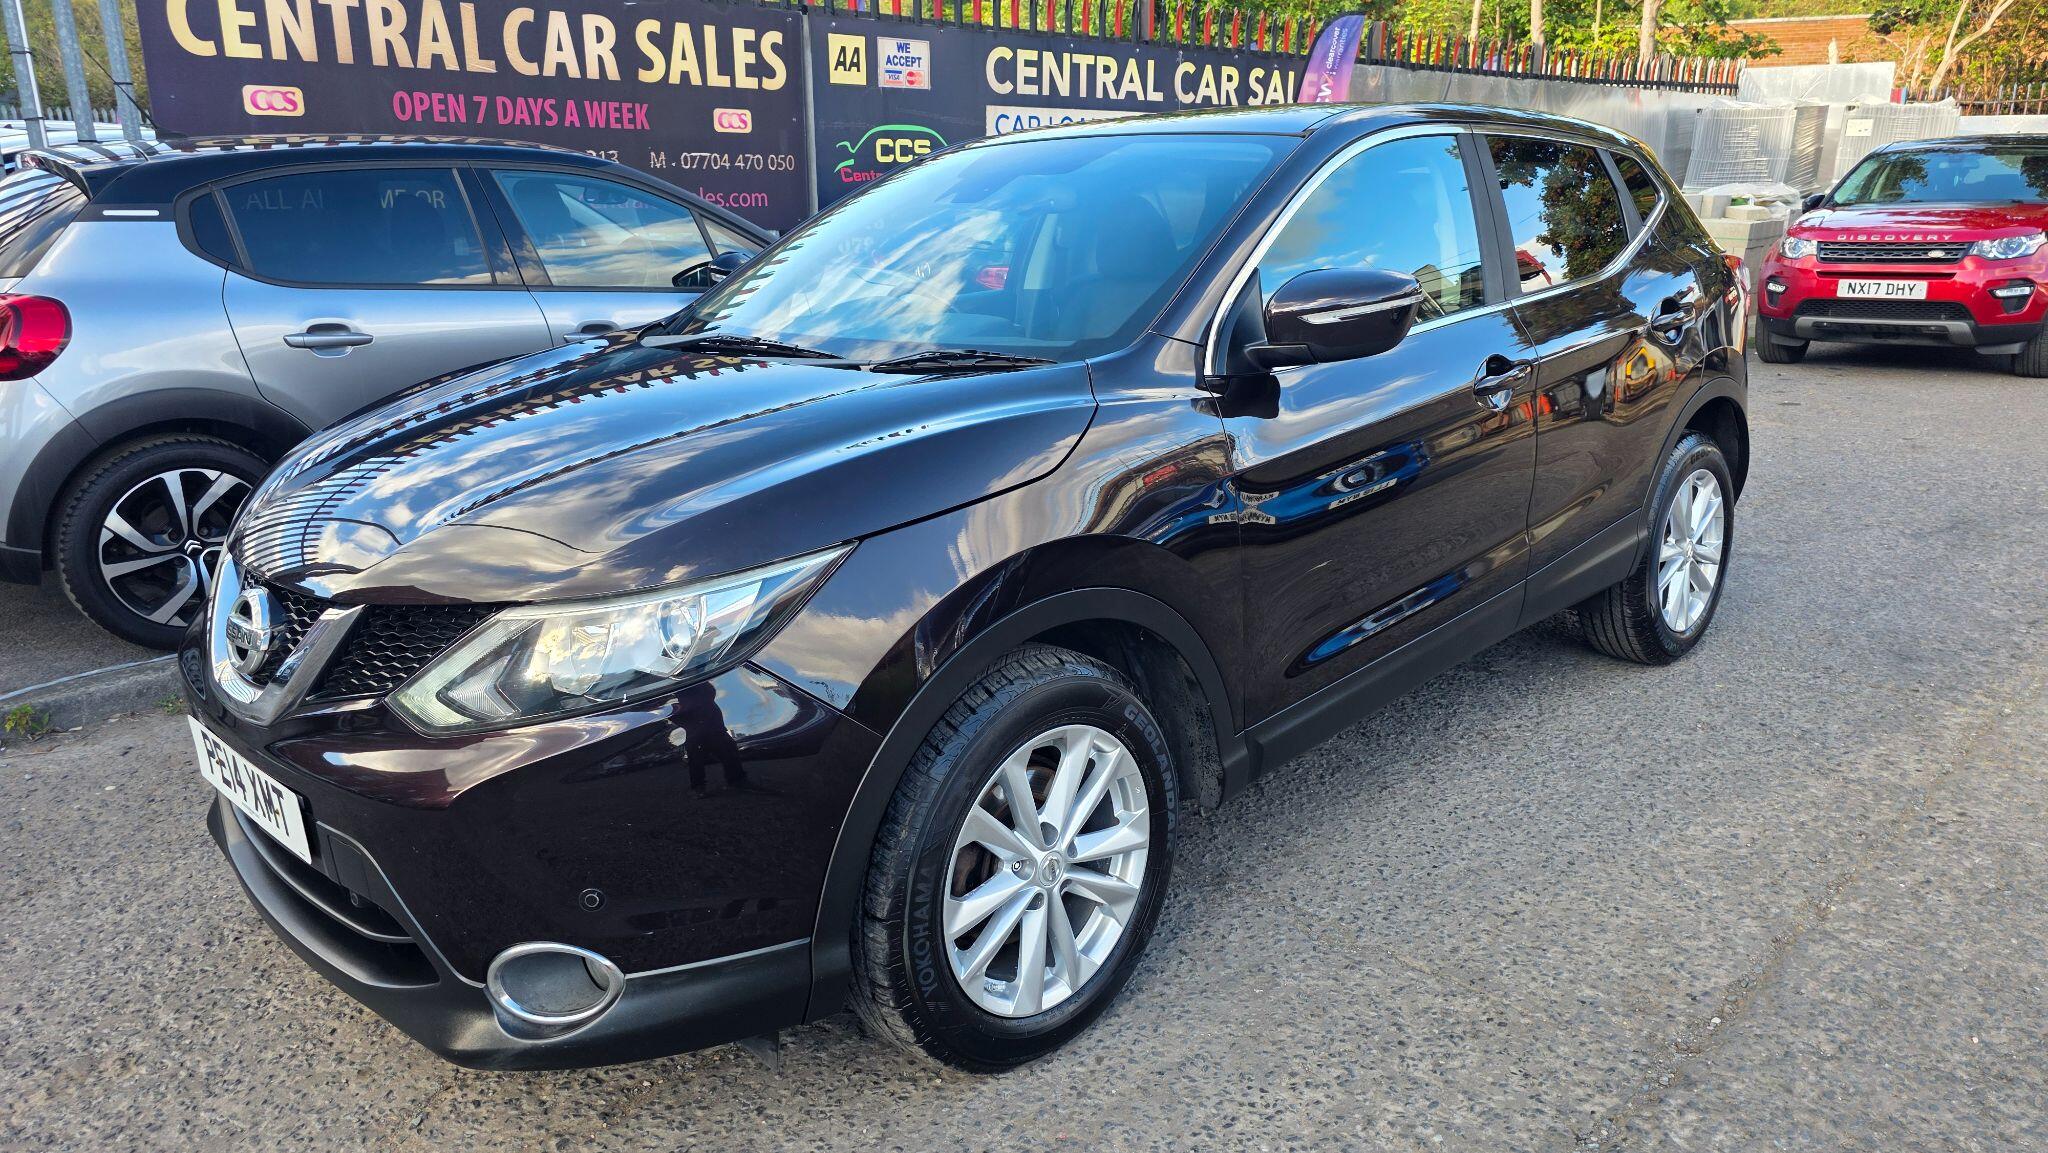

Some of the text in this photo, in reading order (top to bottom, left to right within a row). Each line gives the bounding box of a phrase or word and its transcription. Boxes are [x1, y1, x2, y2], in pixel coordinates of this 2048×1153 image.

[166, 0, 787, 91] CENTRAL CAR SALES
[896, 42, 911, 54] WE
[834, 46, 861, 73] AA
[886, 55, 922, 68] ACCEPT
[985, 46, 1164, 102] CENTRAL
[1175, 61, 1240, 106] CAR
[250, 89, 298, 112] CCS
[393, 91, 650, 130] OPEN 7 DAYS A WEEK
[717, 112, 747, 130] CCS
[681, 152, 730, 170] 07704
[735, 153, 763, 170] 470
[768, 154, 795, 171] 050
[1837, 233, 1953, 241] DISCOVERY
[1847, 282, 1917, 296] NX17 DHY
[201, 729, 290, 837] PE14 XMT
[913, 862, 938, 998] YOKOHAMA
